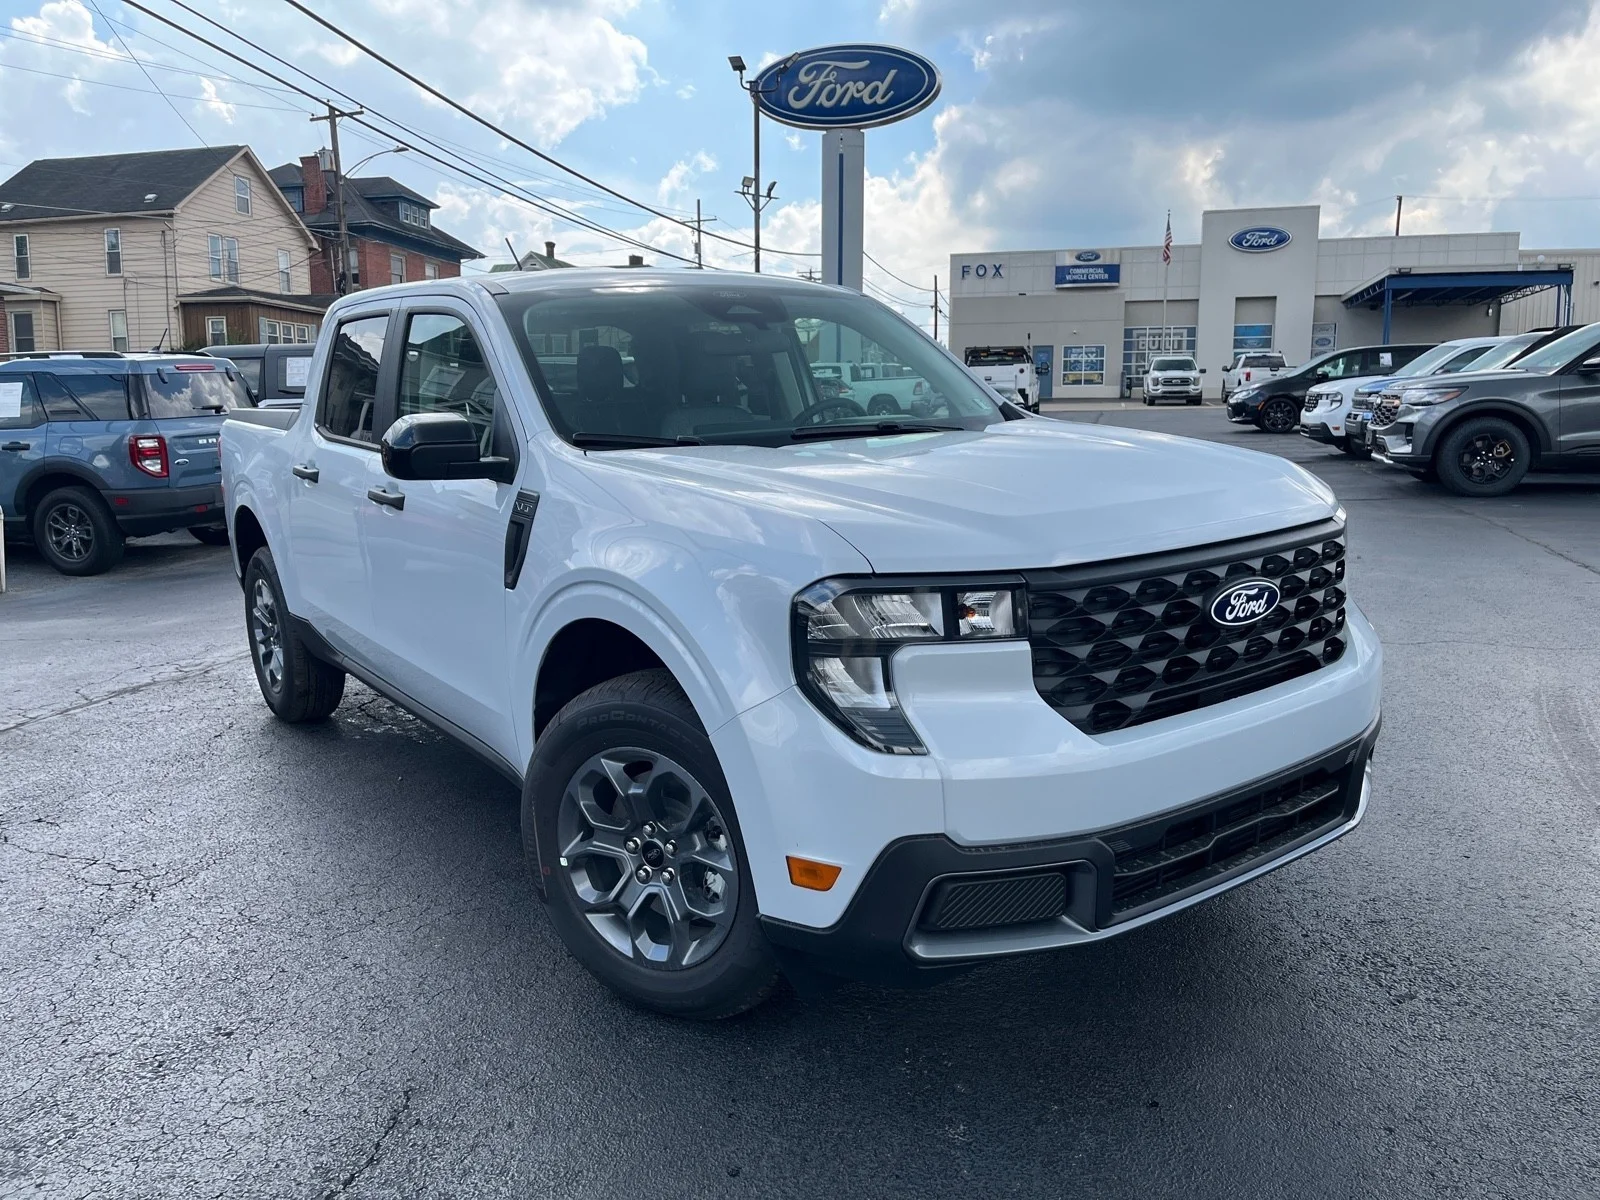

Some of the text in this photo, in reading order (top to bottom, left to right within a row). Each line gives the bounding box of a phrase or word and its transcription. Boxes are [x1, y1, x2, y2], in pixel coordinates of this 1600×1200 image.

[787, 60, 898, 109] Ford
[1242, 231, 1278, 247] Ford
[1080, 252, 1096, 260] Ford
[962, 264, 1003, 279] FOX
[1138, 335, 1183, 350] BUILT
[1070, 353, 1097, 363] FOX
[1225, 588, 1268, 620] Ford
